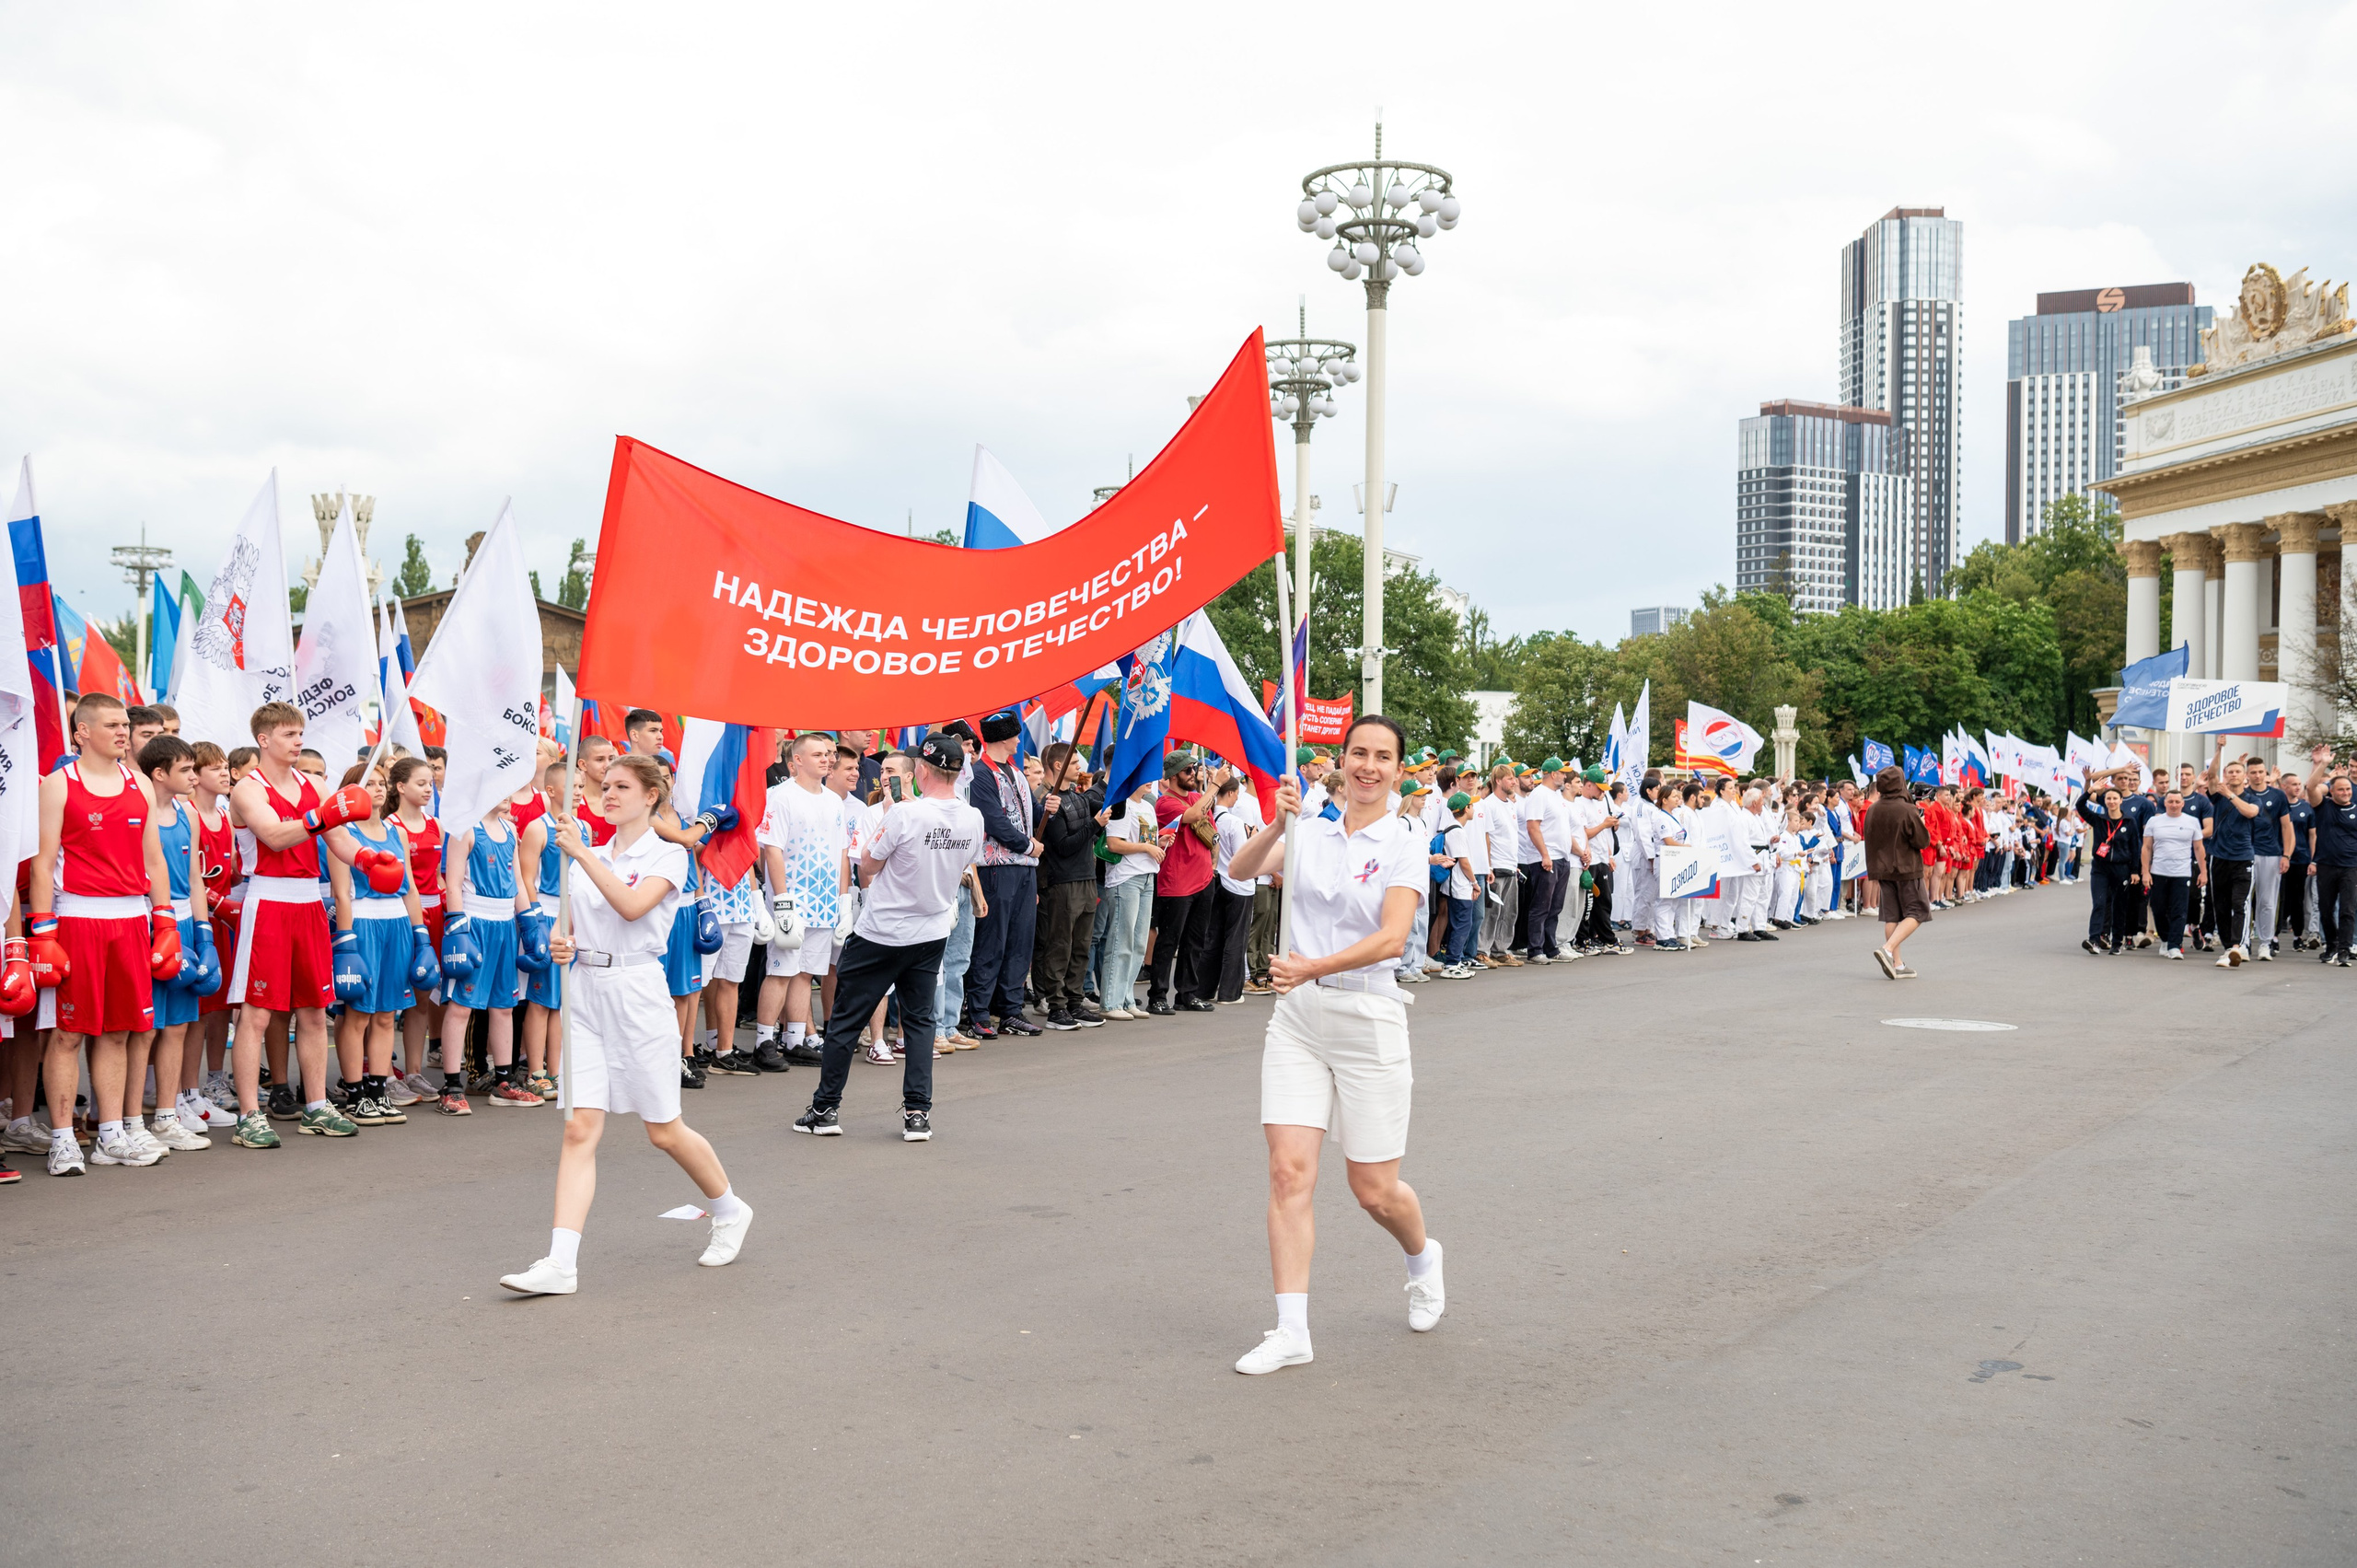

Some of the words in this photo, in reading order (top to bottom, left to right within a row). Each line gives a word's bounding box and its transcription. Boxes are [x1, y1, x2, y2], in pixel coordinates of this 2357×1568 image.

[713, 570, 909, 643] НАДЕЖДА
[921, 517, 1188, 641] ЧЕЛОВЕЧЕСТВА
[743, 627, 963, 676] ЗДОРОВОЕ
[972, 555, 1183, 669] ОТЕЧЕСТВО!
[1317, 705, 1326, 714] НЕ
[2185, 698, 2242, 729] ОТЕЧЕСТВО
[2187, 684, 2241, 716] ЗДОРОВОЕ
[503, 707, 537, 736] БОКС
[1303, 713, 1319, 723] УСТЬ
[336, 791, 350, 819] clinch
[930, 839, 972, 851] ОБЪЕДИНЯЕТ
[1670, 860, 1698, 896] ДЗЮДО
[444, 952, 468, 963] clinch
[336, 973, 362, 985] clinch
